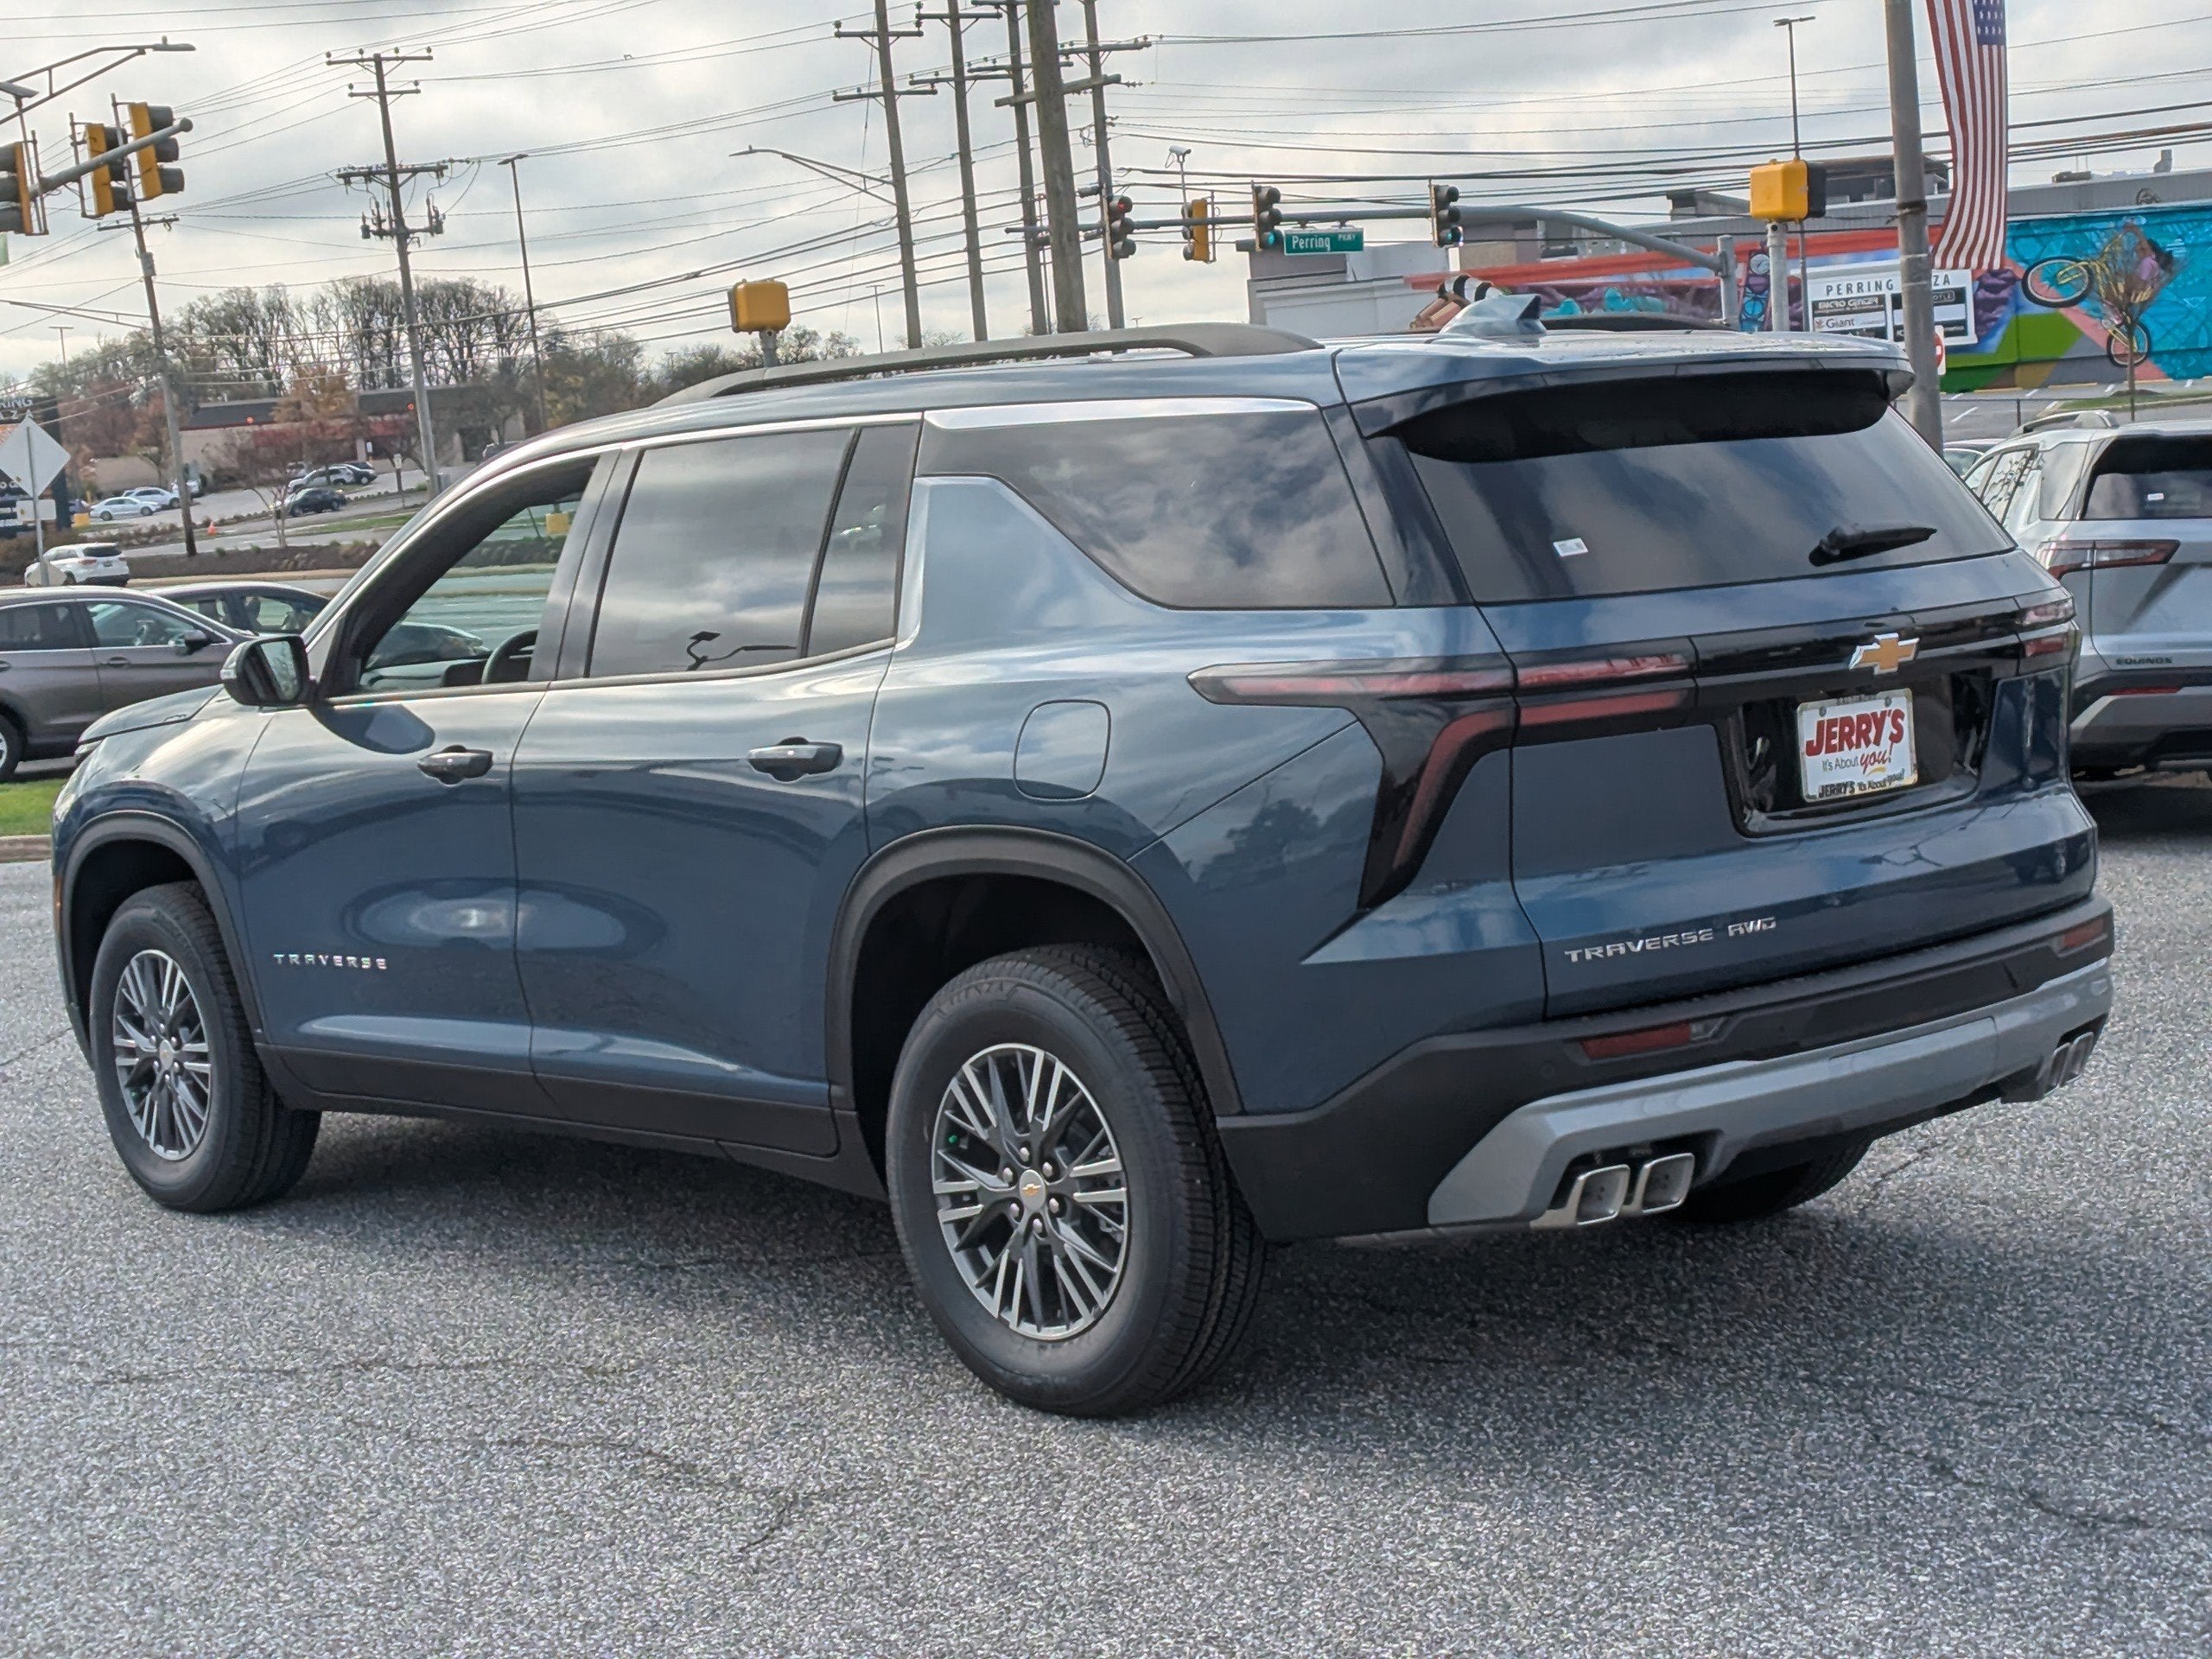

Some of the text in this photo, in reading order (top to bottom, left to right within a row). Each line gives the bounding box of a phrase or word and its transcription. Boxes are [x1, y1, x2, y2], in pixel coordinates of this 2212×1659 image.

[1292, 235, 1331, 251] Perring
[1826, 279, 1894, 296] PERRING
[1825, 317, 1855, 328] Giant
[1805, 709, 1905, 757] JERRY'S
[1834, 756, 1859, 770] About
[1818, 780, 1855, 798] JERRY'S
[1565, 917, 1777, 963] TRAVERSE AWD
[273, 953, 387, 969] TRAVERSE
